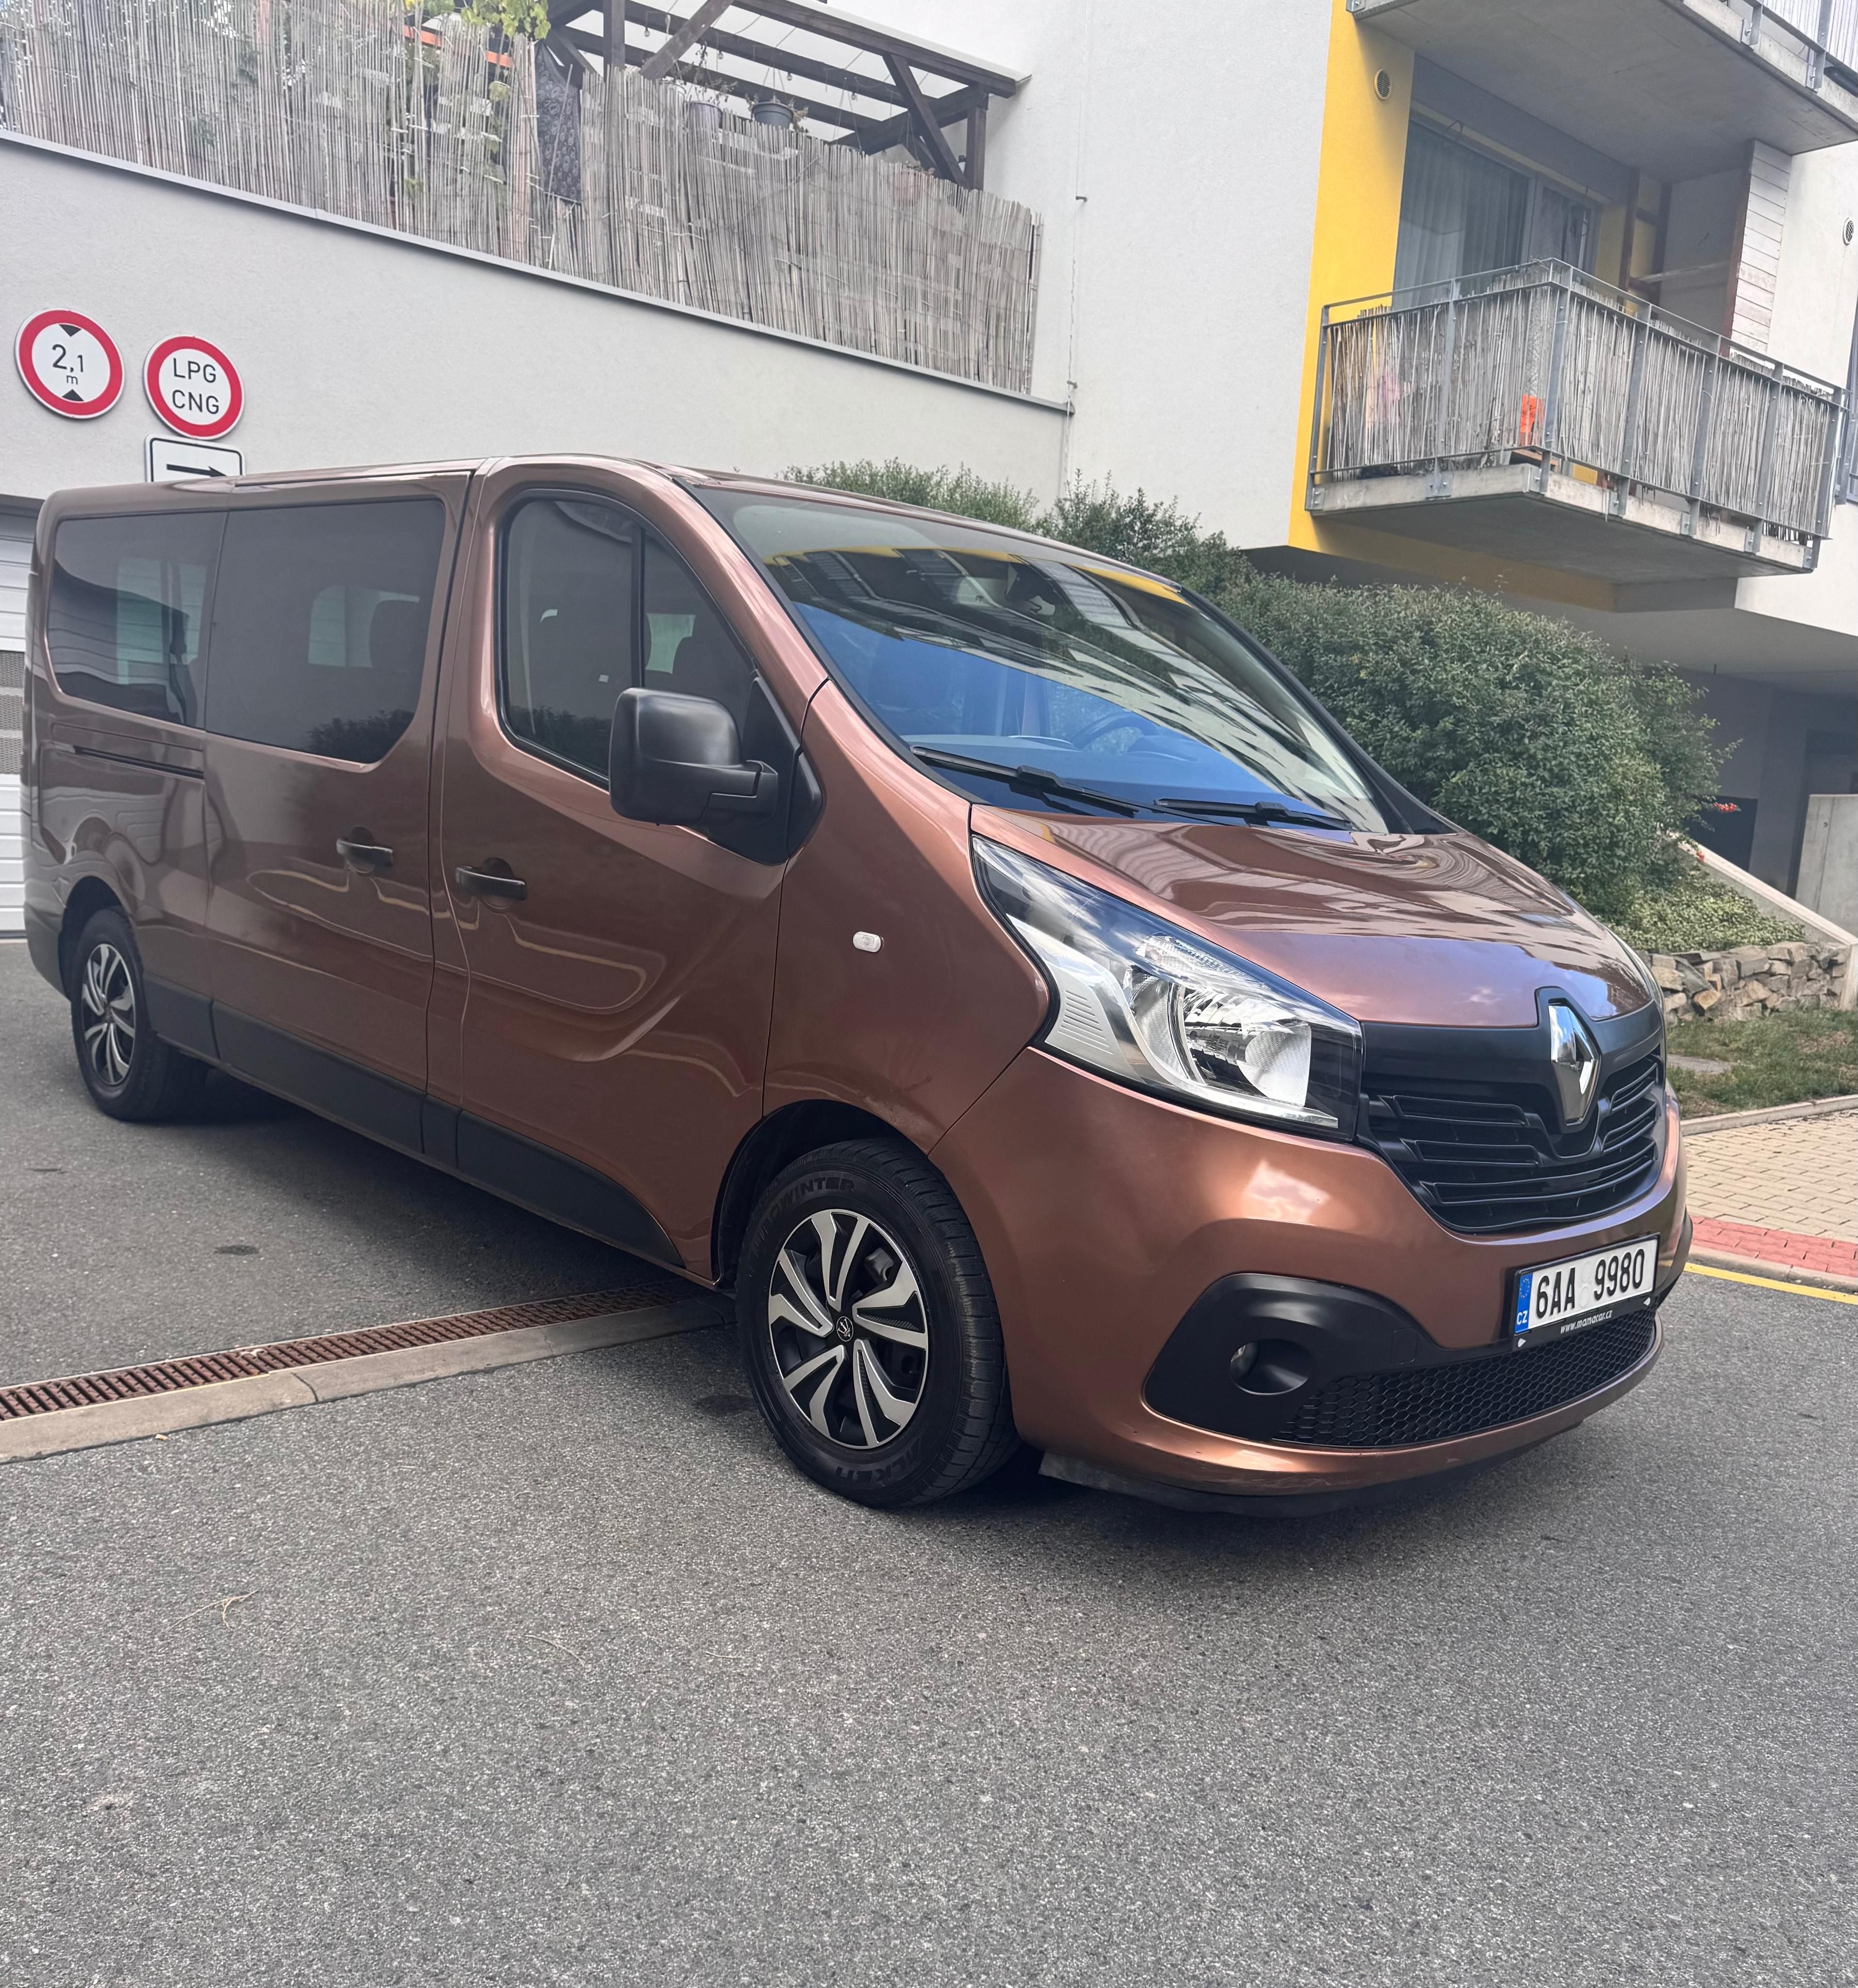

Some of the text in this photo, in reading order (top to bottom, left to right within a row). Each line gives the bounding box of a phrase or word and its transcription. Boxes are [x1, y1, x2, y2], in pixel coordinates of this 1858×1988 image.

[52, 344, 83, 373] 2,1
[173, 358, 216, 383] LPG
[66, 375, 78, 385] m
[172, 390, 219, 414] CNG
[1536, 1249, 1644, 1319] 6AA 9980
[1517, 1310, 1528, 1325] CZ
[1561, 1310, 1613, 1334] www.mamacar.cz
